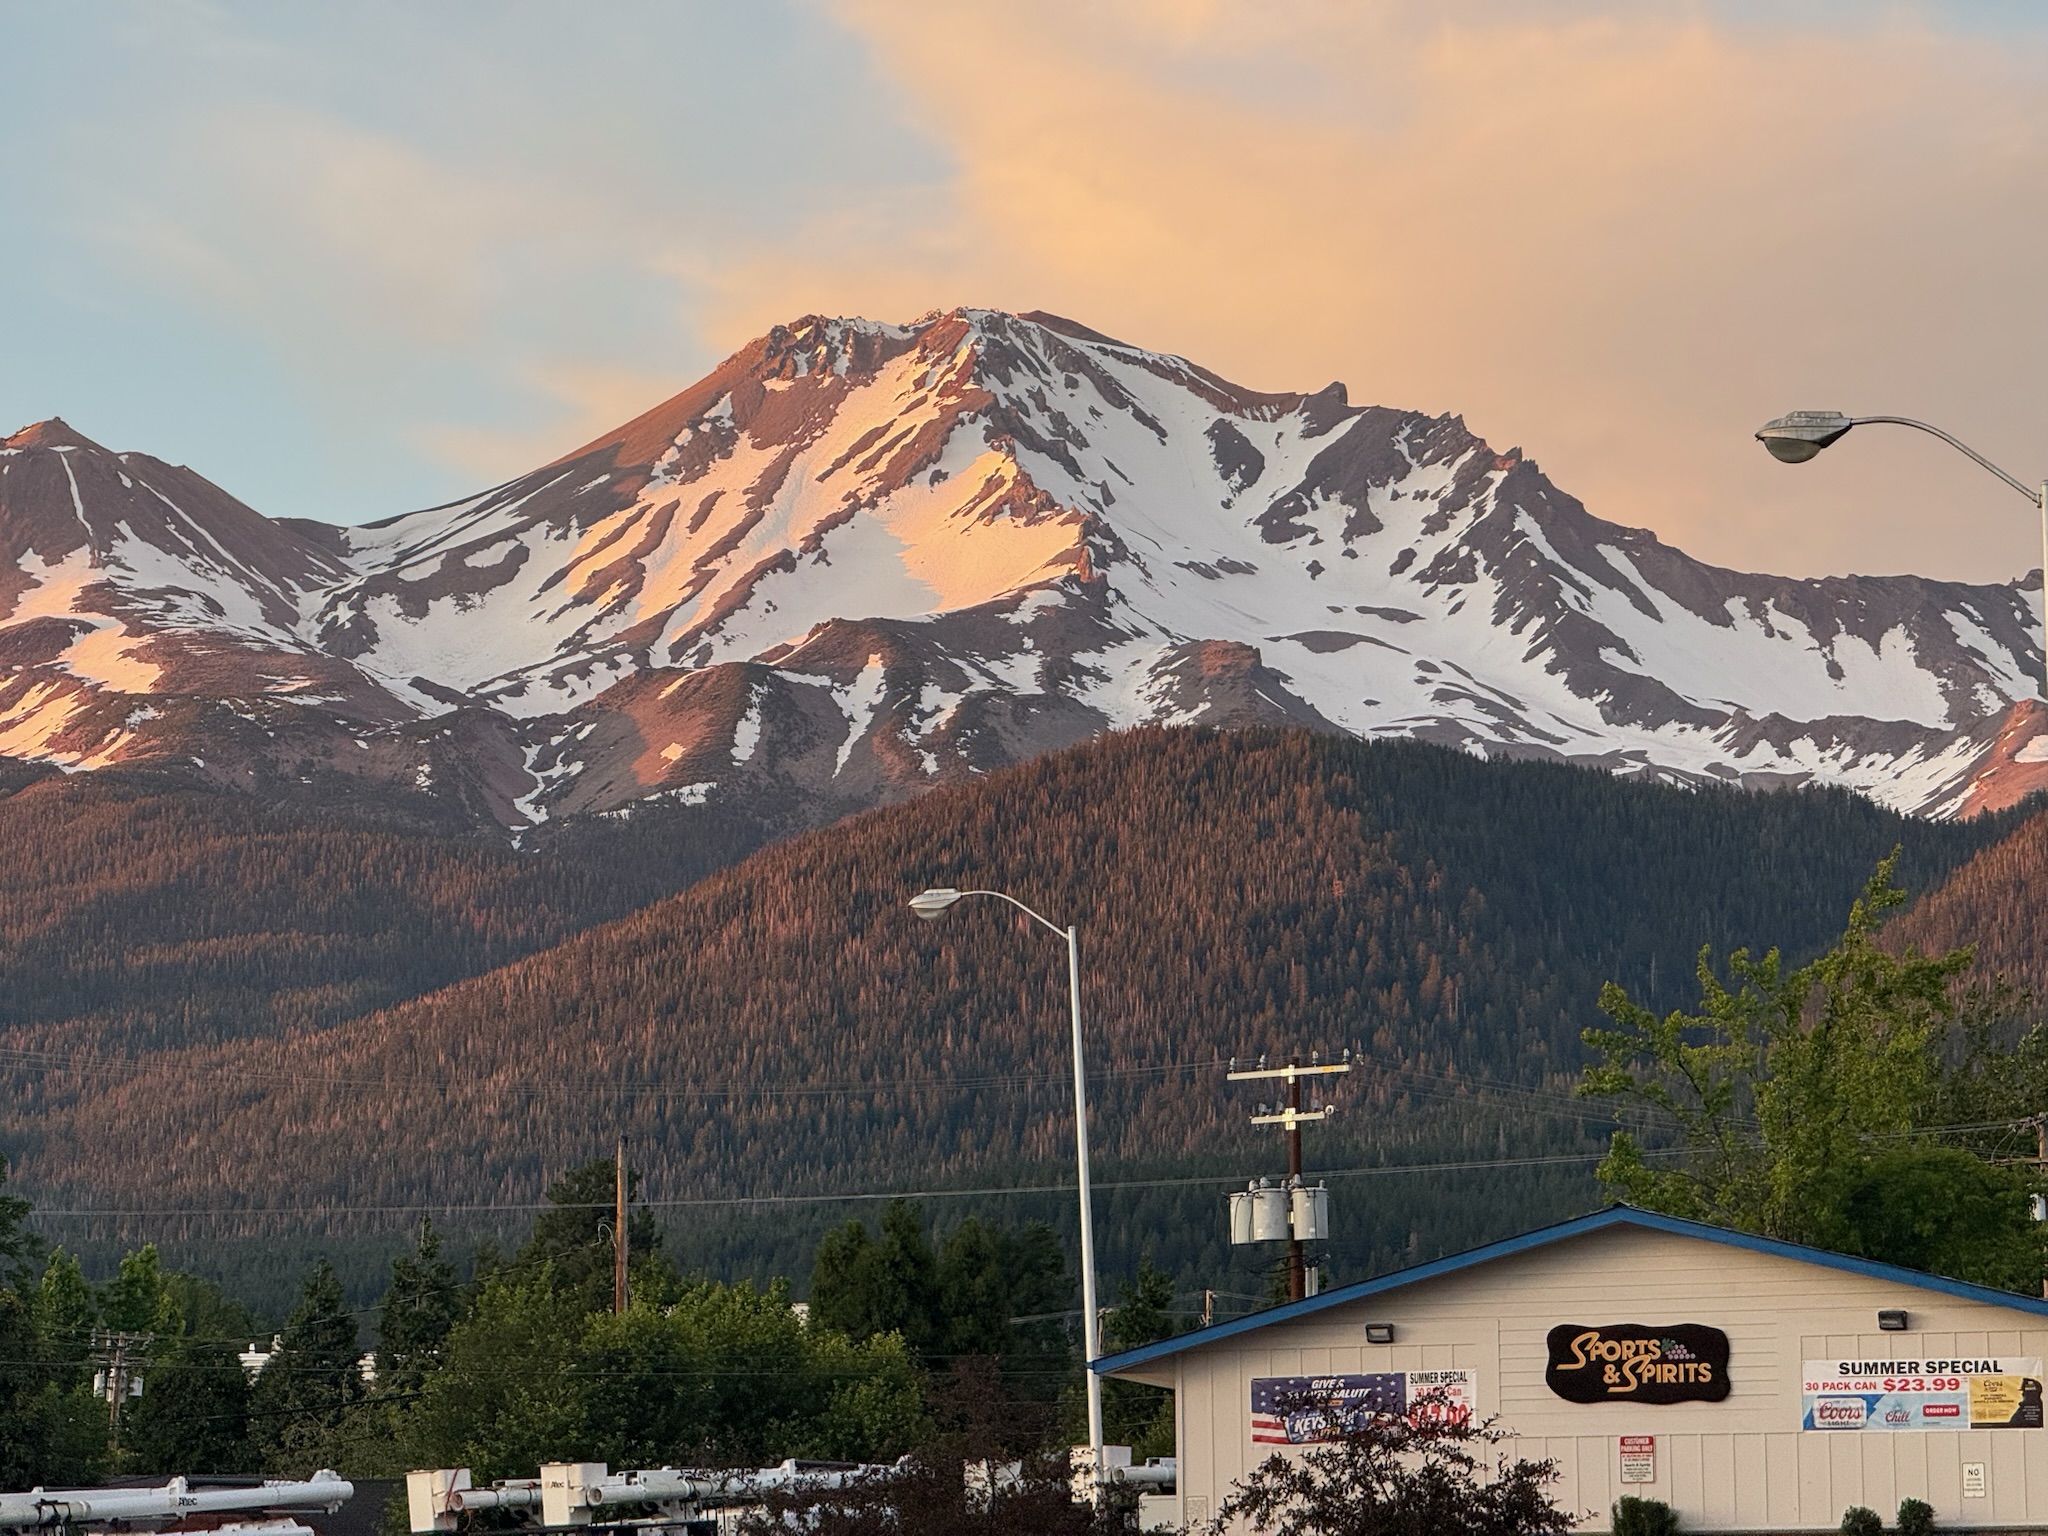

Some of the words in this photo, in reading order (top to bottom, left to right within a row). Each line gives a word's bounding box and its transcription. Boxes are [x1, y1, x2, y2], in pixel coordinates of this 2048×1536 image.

[1556, 1331, 1662, 1370] SPORTS
[1603, 1364, 1620, 1384] &
[1607, 1354, 1712, 1392] SPIRITS
[1839, 1361, 1920, 1375] SUMMER
[1925, 1360, 2003, 1374] SPECIAL
[1312, 1379, 1337, 1389] GIVE
[1410, 1373, 1438, 1384] SUMMER
[1440, 1371, 1468, 1383] SPECIAL
[1447, 1386, 1462, 1396] Can
[1805, 1382, 1818, 1391] 30
[1822, 1381, 1851, 1391] PACK
[1854, 1381, 1877, 1390] CAN
[1883, 1378, 1960, 1392] $23.99
[1819, 1402, 1861, 1420] Coors
[1885, 1410, 1910, 1422] Chill
[1968, 1468, 1979, 1476] NO
